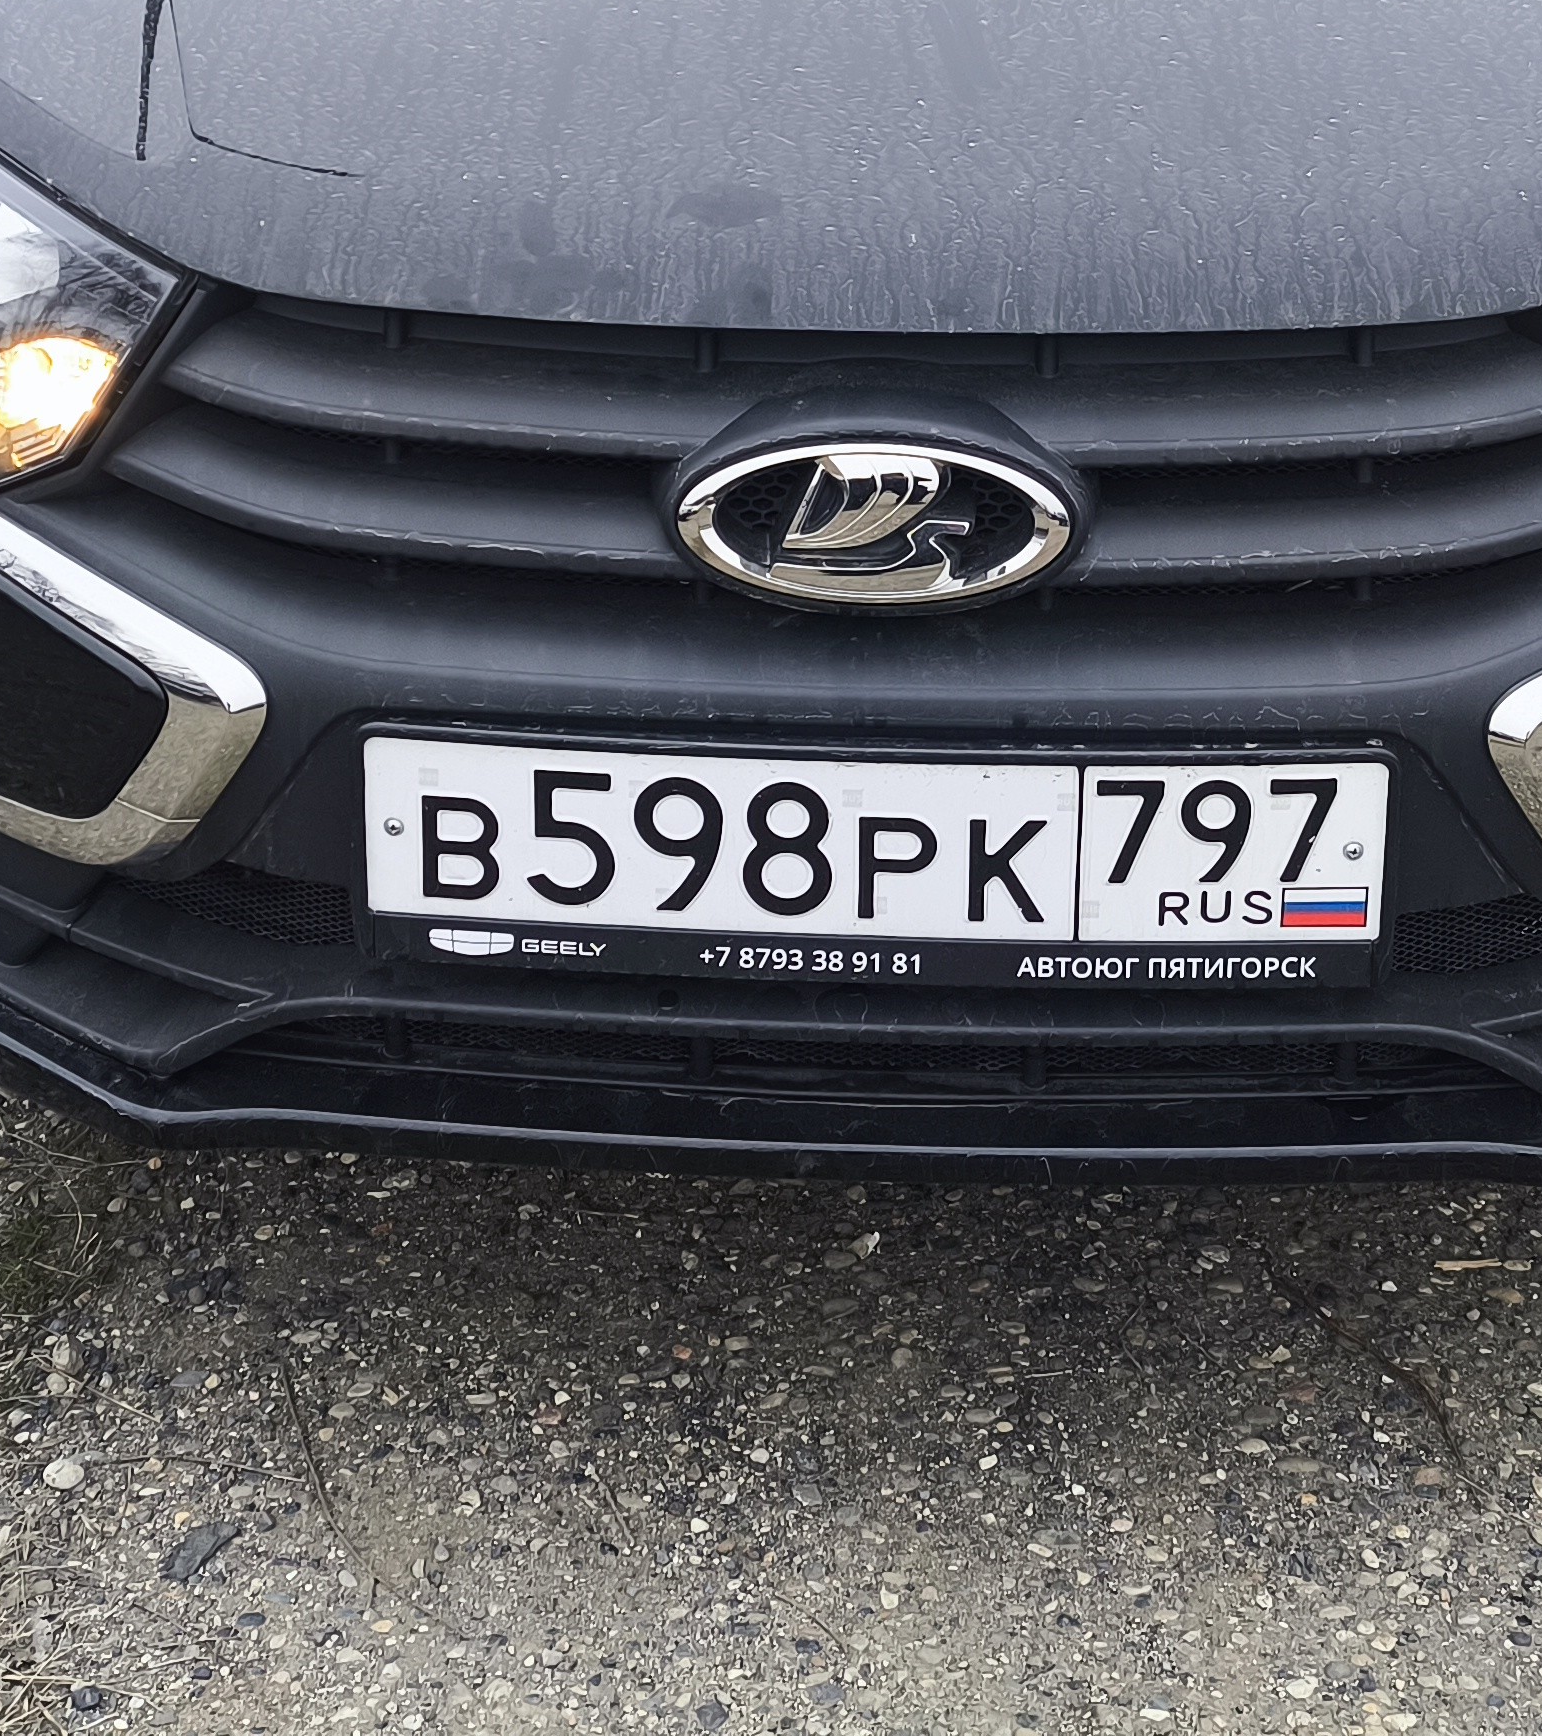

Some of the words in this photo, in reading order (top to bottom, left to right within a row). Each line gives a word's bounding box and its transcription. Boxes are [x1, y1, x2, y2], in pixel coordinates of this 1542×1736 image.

[1096, 779, 1338, 884] 797
[1158, 890, 1273, 926] RUS
[521, 938, 607, 957] GEELY
[699, 947, 730, 968] +7
[739, 948, 804, 971] 8793
[811, 949, 844, 972] 38
[852, 951, 880, 973] 91
[892, 952, 920, 975] 81
[1016, 956, 1140, 979] АВТОЮГ
[1148, 956, 1317, 979] ПЯТИГОРСК
